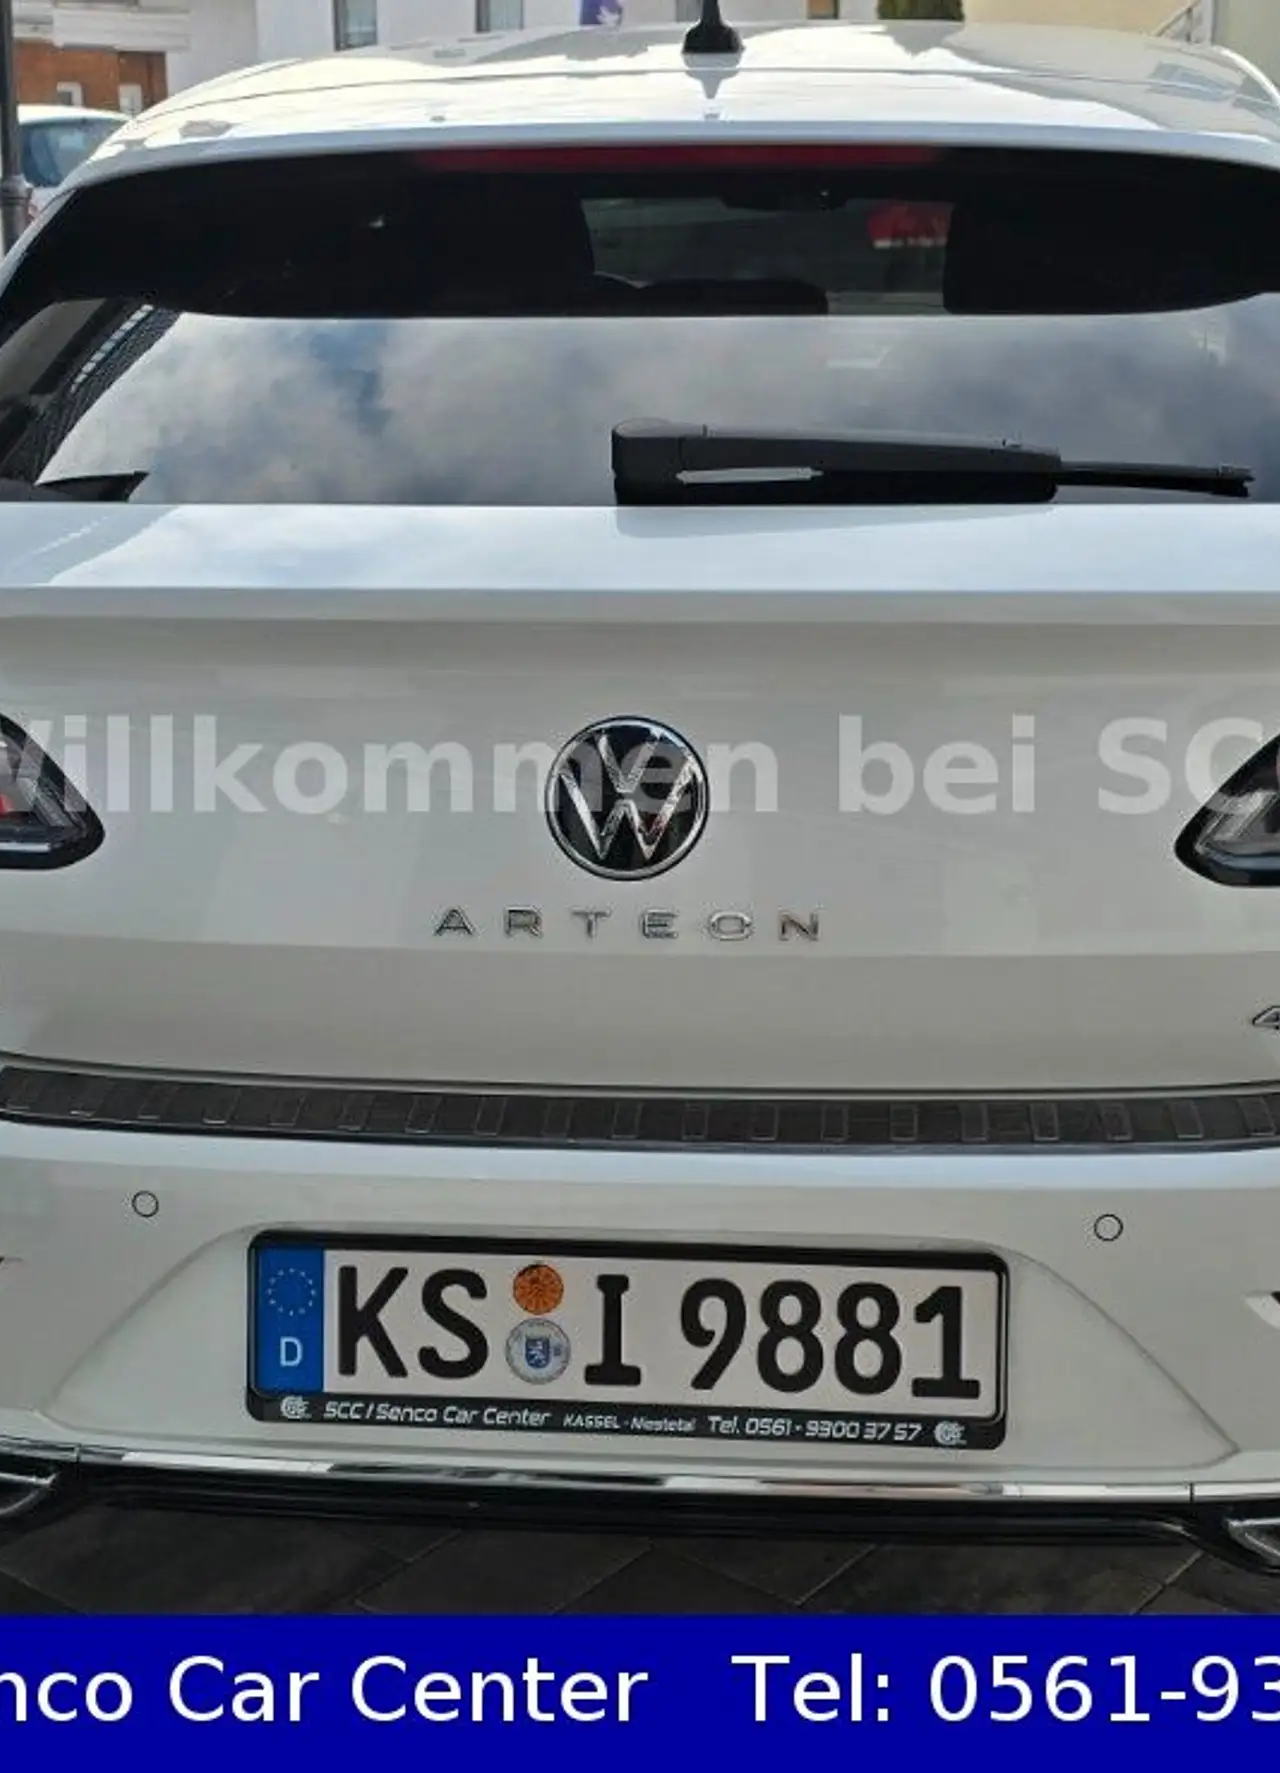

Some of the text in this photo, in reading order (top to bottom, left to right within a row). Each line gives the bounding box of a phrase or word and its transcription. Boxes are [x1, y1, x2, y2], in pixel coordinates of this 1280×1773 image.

[433, 905, 820, 942] ARTEON
[337, 1264, 980, 1400] KS I 9881
[279, 1335, 304, 1369] D
[323, 1400, 365, 1420] SCC
[376, 1402, 437, 1422] Senco
[442, 1406, 478, 1424] Car
[483, 1406, 552, 1427] Center
[562, 1413, 620, 1429] KASSEL
[707, 1415, 739, 1434] Tel.
[745, 1417, 792, 1436] 0561
[805, 1420, 860, 1438] 9300
